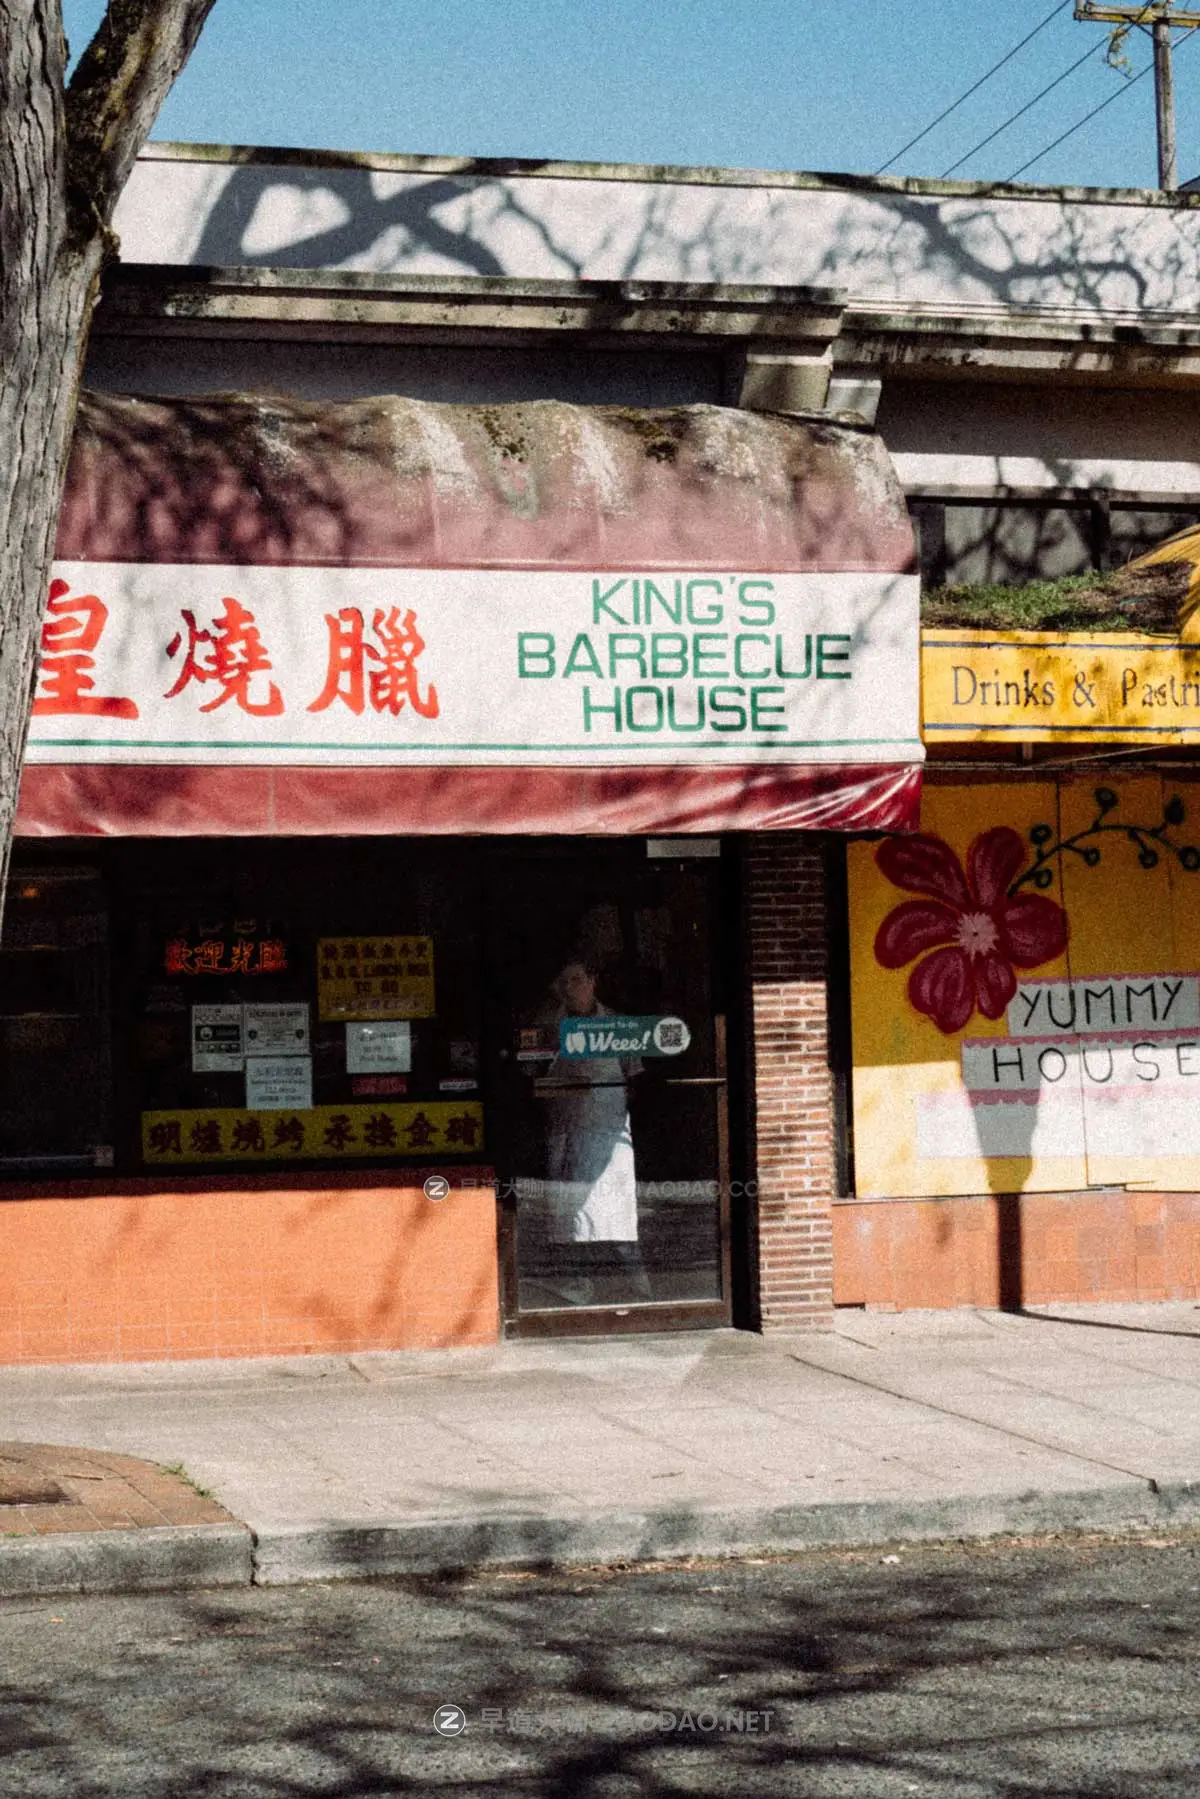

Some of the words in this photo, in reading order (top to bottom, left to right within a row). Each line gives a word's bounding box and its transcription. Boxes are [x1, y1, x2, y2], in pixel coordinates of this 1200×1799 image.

[592, 577, 776, 626] KING'S
[517, 632, 852, 680] BARBECUE
[582, 686, 789, 732] HOUSE
[952, 665, 1055, 707] Drinks
[1072, 671, 1097, 707] &
[1019, 980, 1184, 1029] YUMMY
[588, 1030, 652, 1052] Weee!
[992, 1042, 1200, 1083] HOUSE
